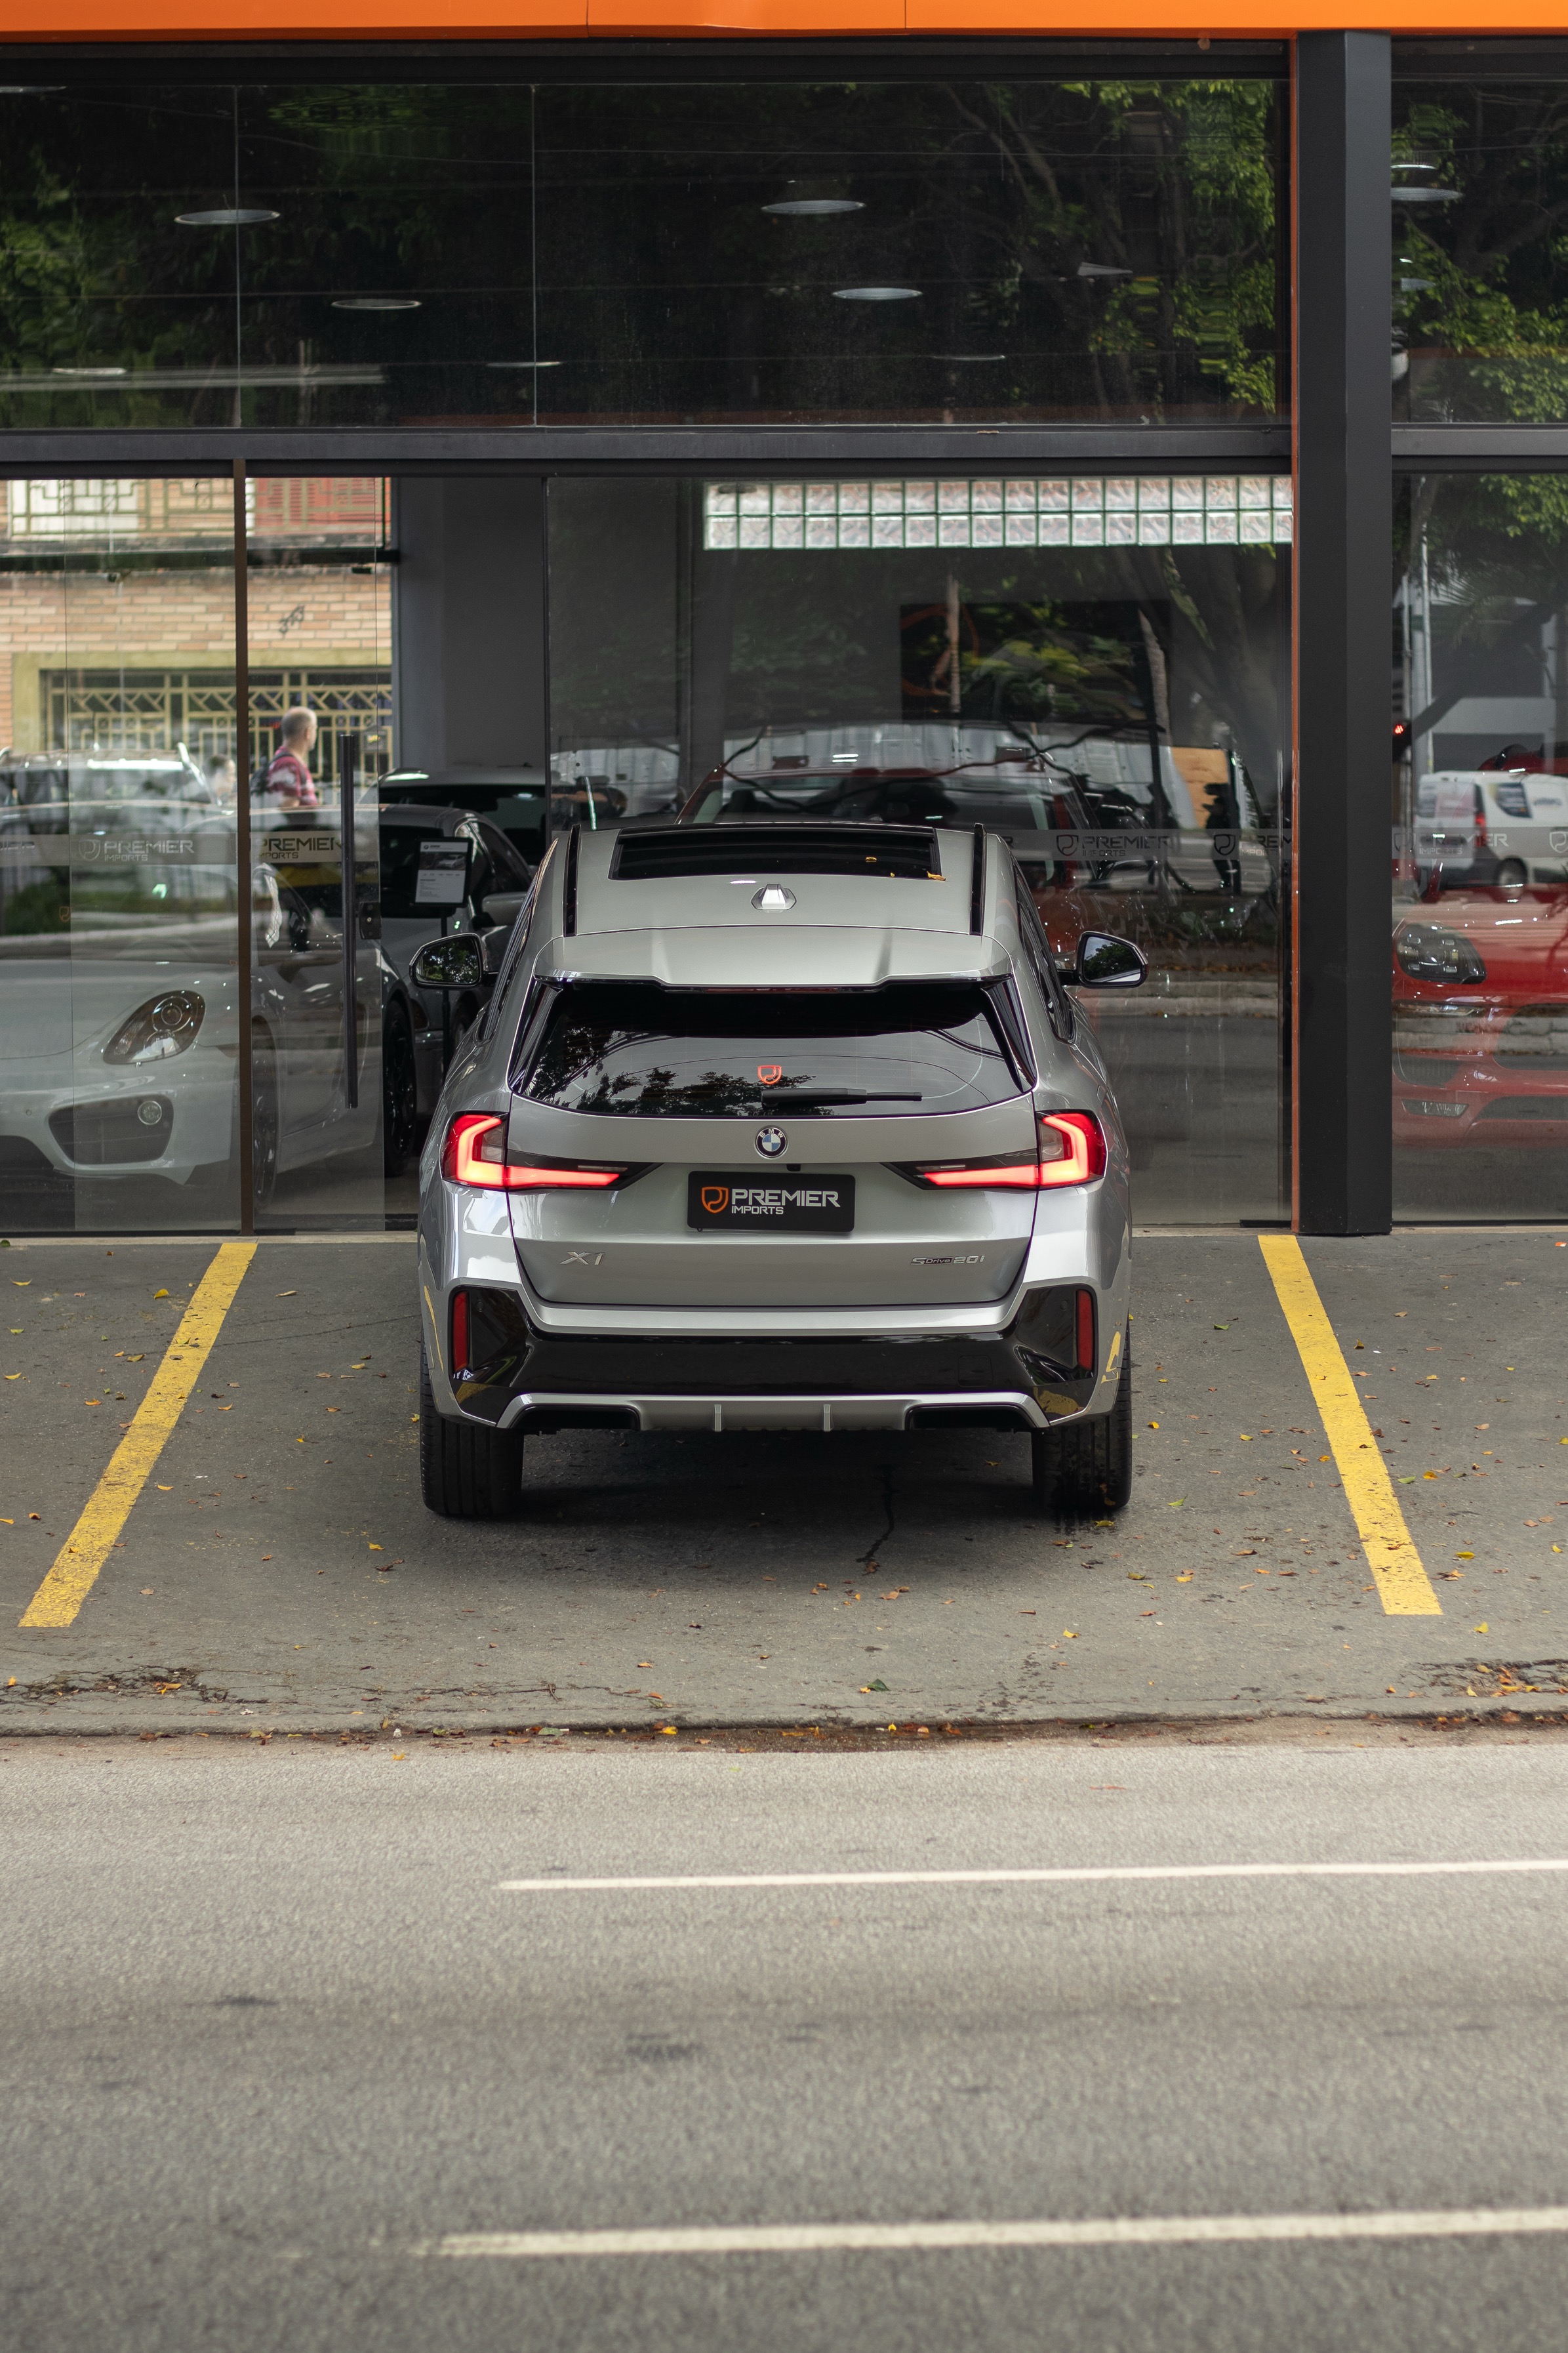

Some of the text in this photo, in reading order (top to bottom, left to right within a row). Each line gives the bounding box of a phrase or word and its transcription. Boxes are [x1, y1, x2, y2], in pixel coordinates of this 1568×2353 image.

[104, 840, 195, 853] PREMIER
[759, 1128, 784, 1138] BMW
[731, 1189, 841, 1207] PREMIER
[731, 1205, 784, 1215] IMPORTS
[559, 1252, 604, 1265] X1
